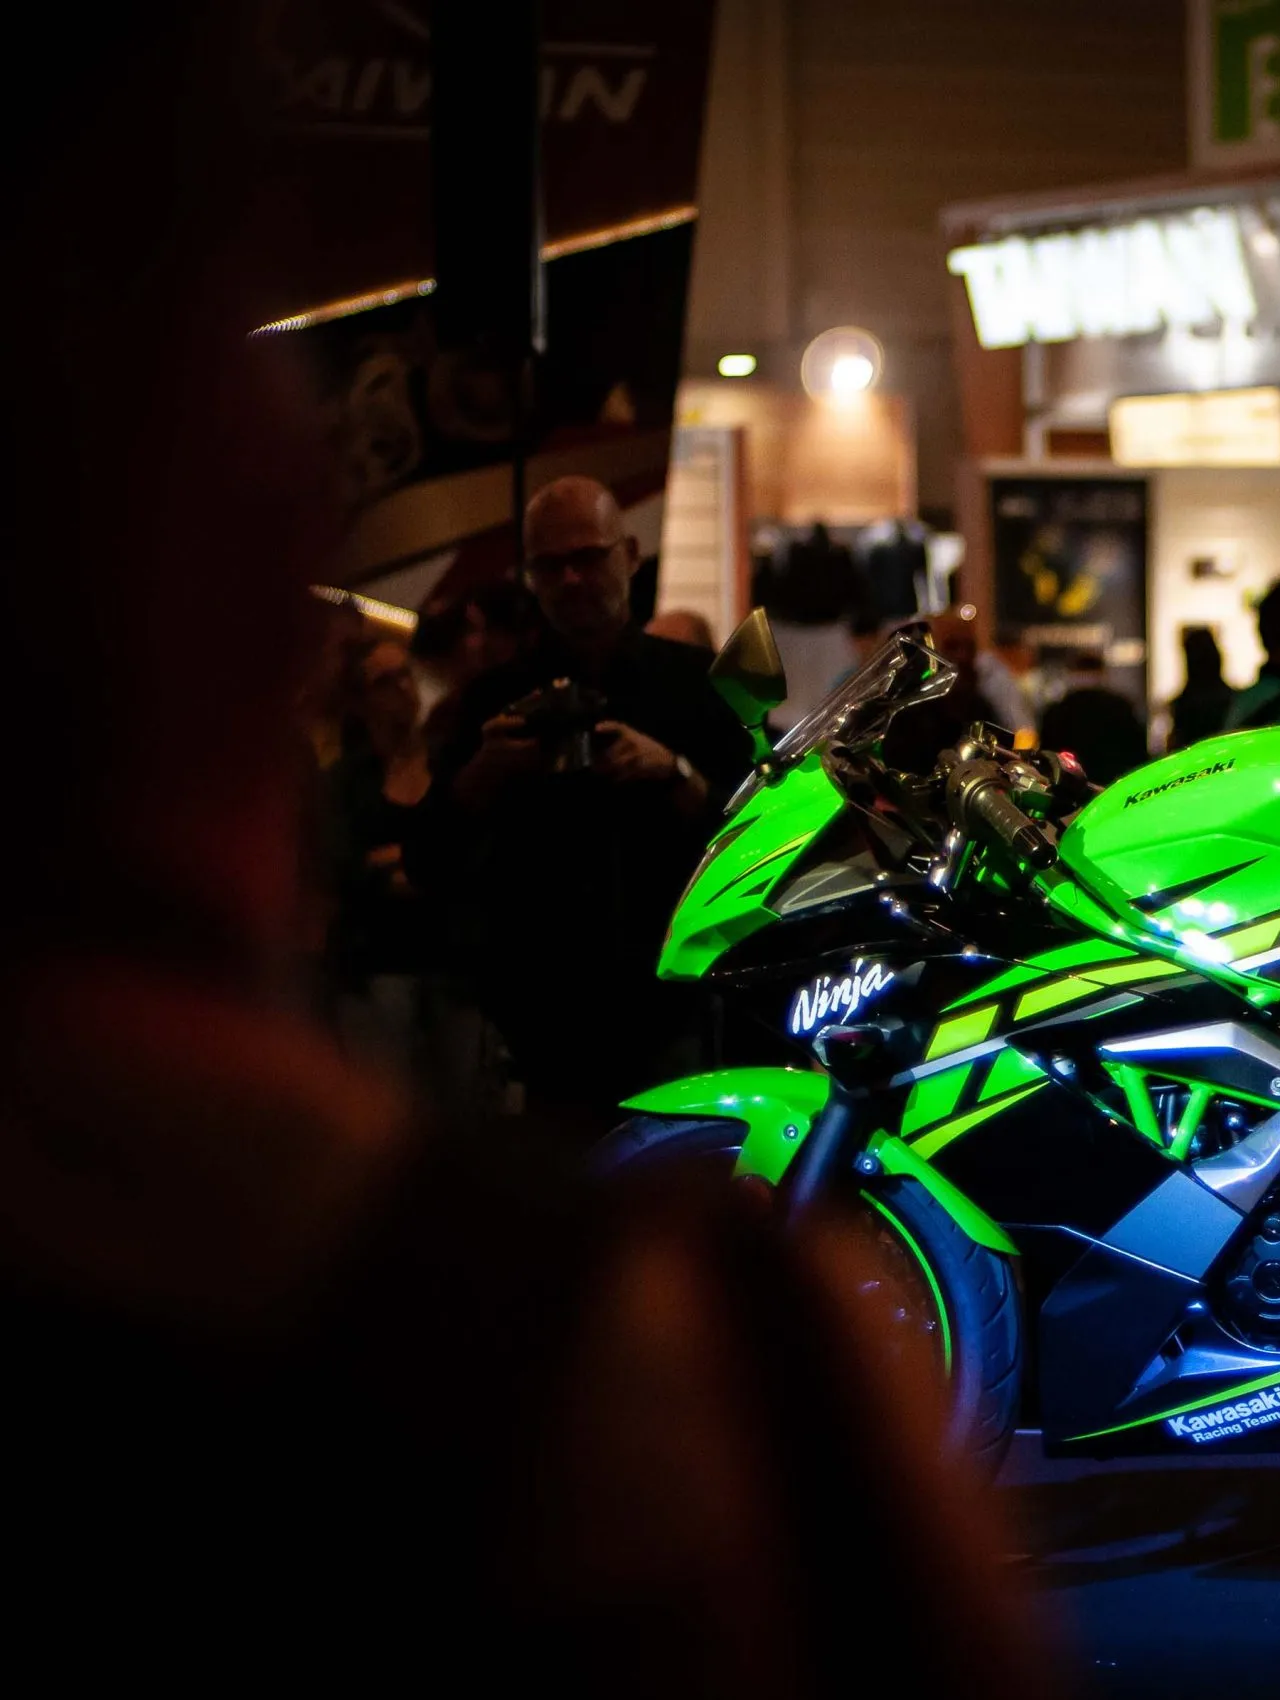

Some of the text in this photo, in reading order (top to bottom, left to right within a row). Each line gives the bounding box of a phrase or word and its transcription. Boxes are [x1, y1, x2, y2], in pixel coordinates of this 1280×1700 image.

[1123, 758, 1236, 809] Kawasaki
[792, 957, 895, 1034] Ninja
[1191, 1423, 1243, 1443] Racing
